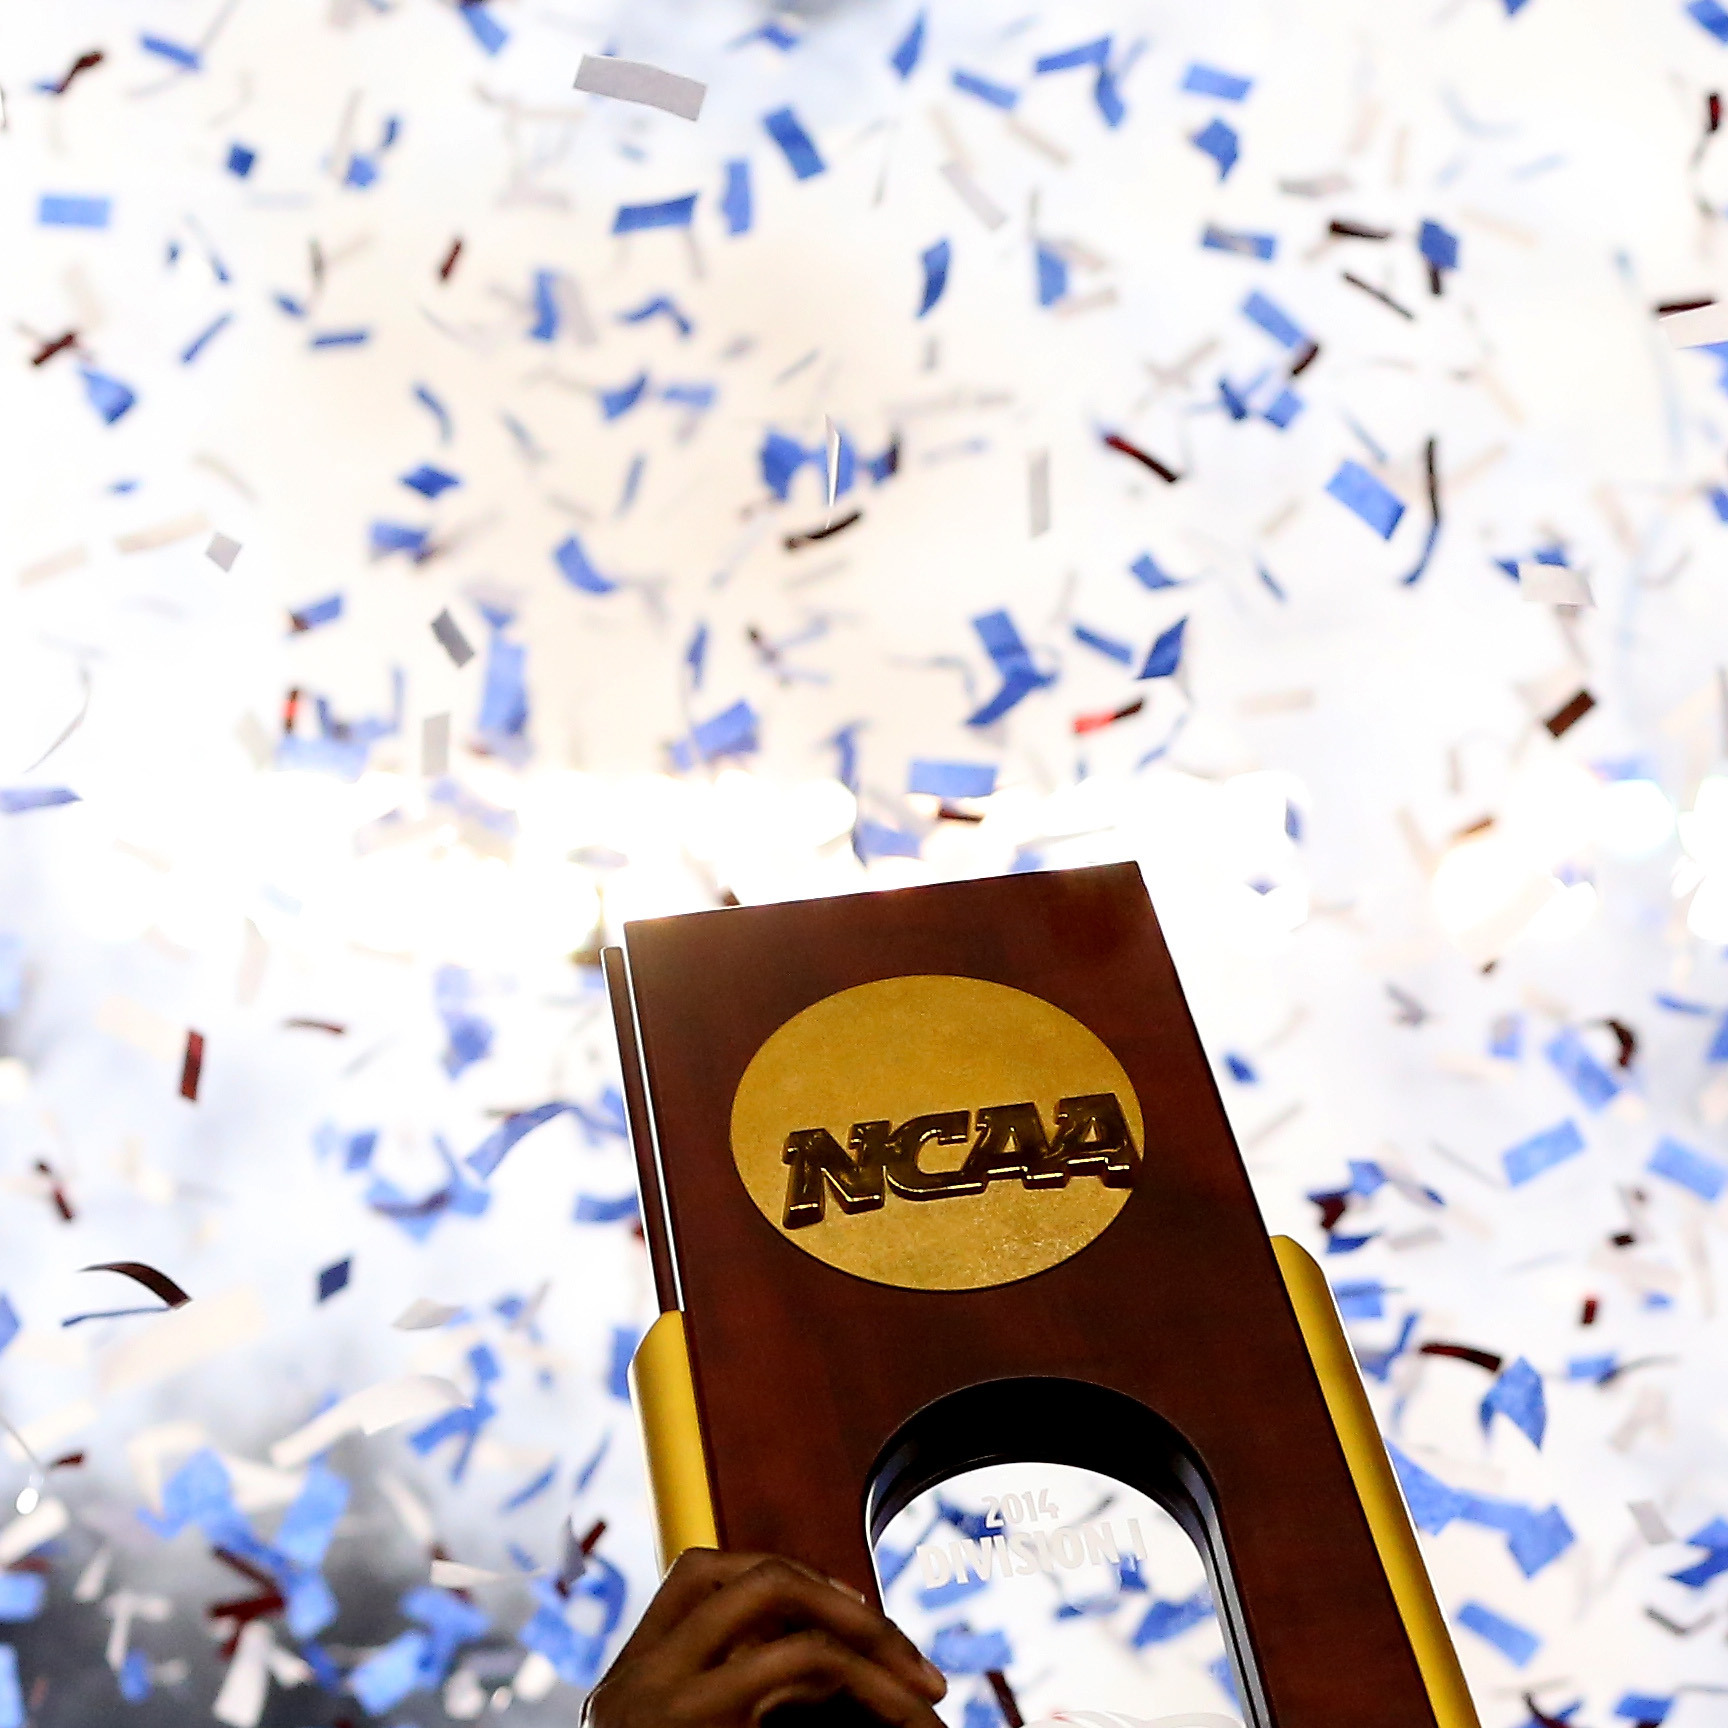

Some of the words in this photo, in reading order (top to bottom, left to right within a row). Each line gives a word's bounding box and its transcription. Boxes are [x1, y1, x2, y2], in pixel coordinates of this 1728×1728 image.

[780, 1092, 1144, 1229] NCAA
[981, 1488, 1060, 1529] 2014
[915, 1520, 1121, 1590] DIVISION
[1127, 1517, 1148, 1561] I
